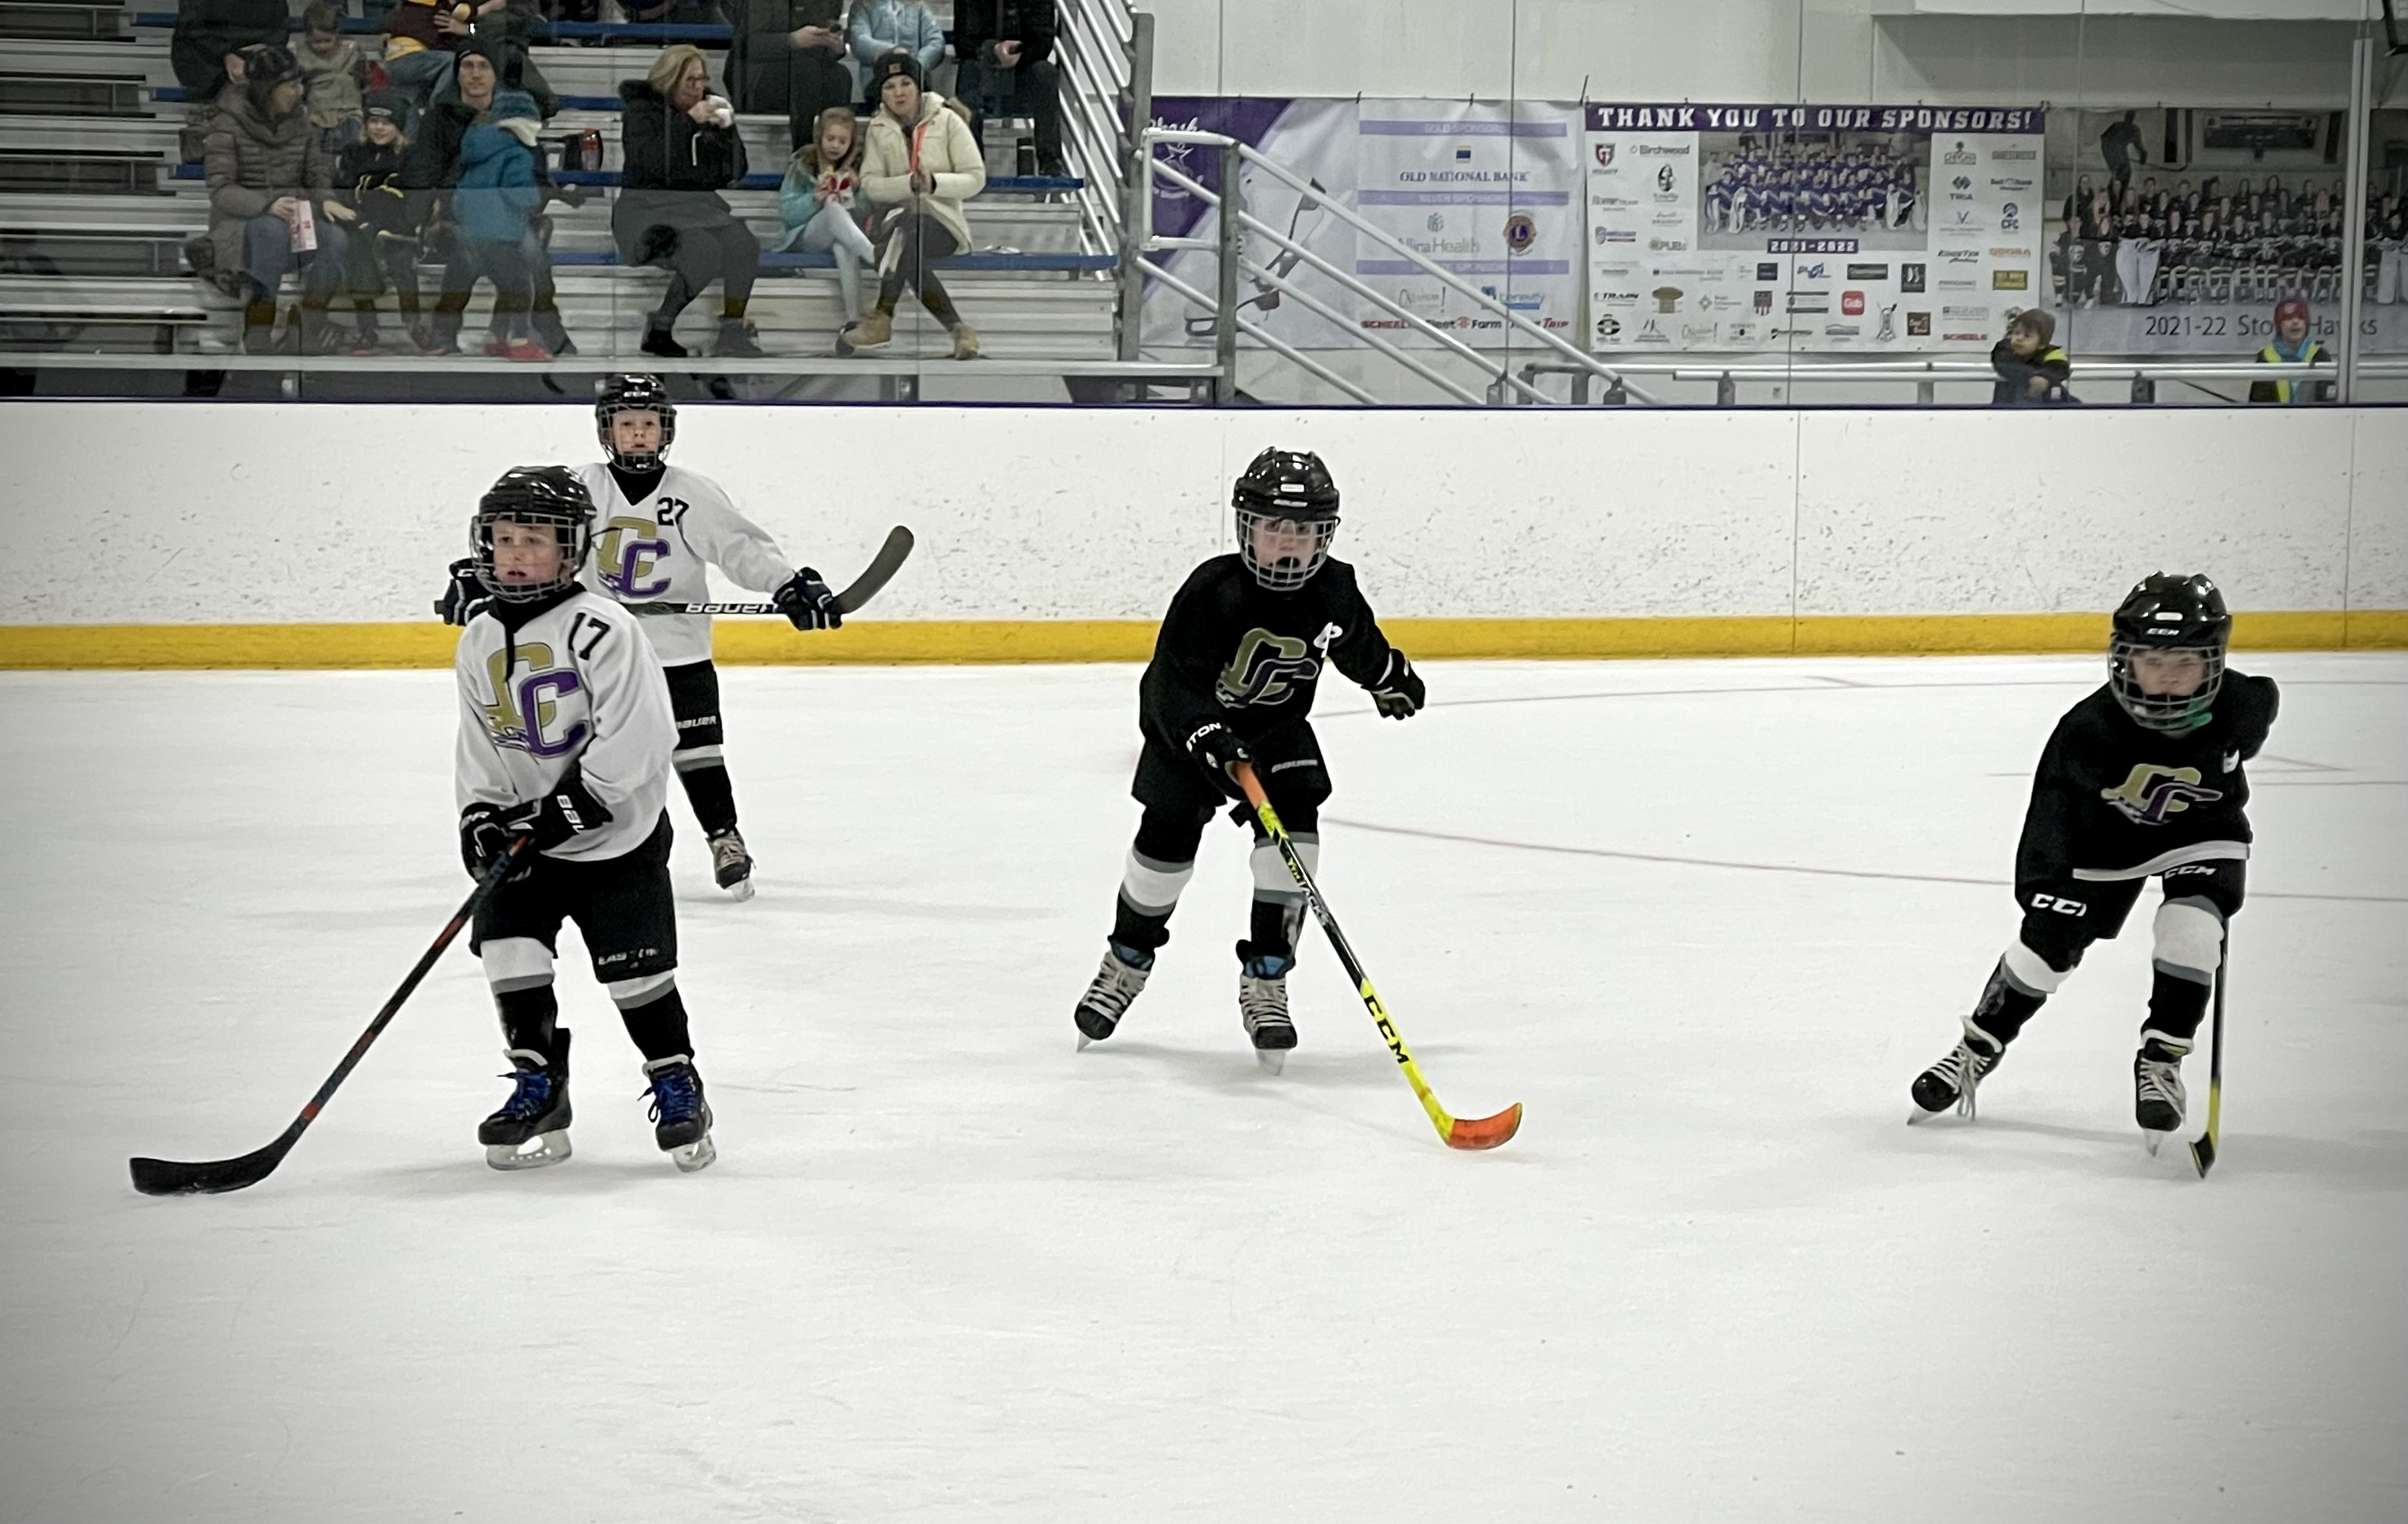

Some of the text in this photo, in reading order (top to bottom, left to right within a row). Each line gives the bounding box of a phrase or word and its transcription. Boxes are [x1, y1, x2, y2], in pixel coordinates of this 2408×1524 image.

[1598, 108, 2032, 129] THANK YOU TO OUR SPONSORS!
[1400, 171, 1529, 182] OLD NATIONAL BANK
[1771, 240, 1855, 252] 2021-2022
[1471, 319, 1502, 329] Farm
[2145, 314, 2378, 336] 2021-22 Sto Haks
[657, 497, 689, 526] 27
[567, 612, 610, 661] 17
[1365, 994, 1410, 1065] CCM
